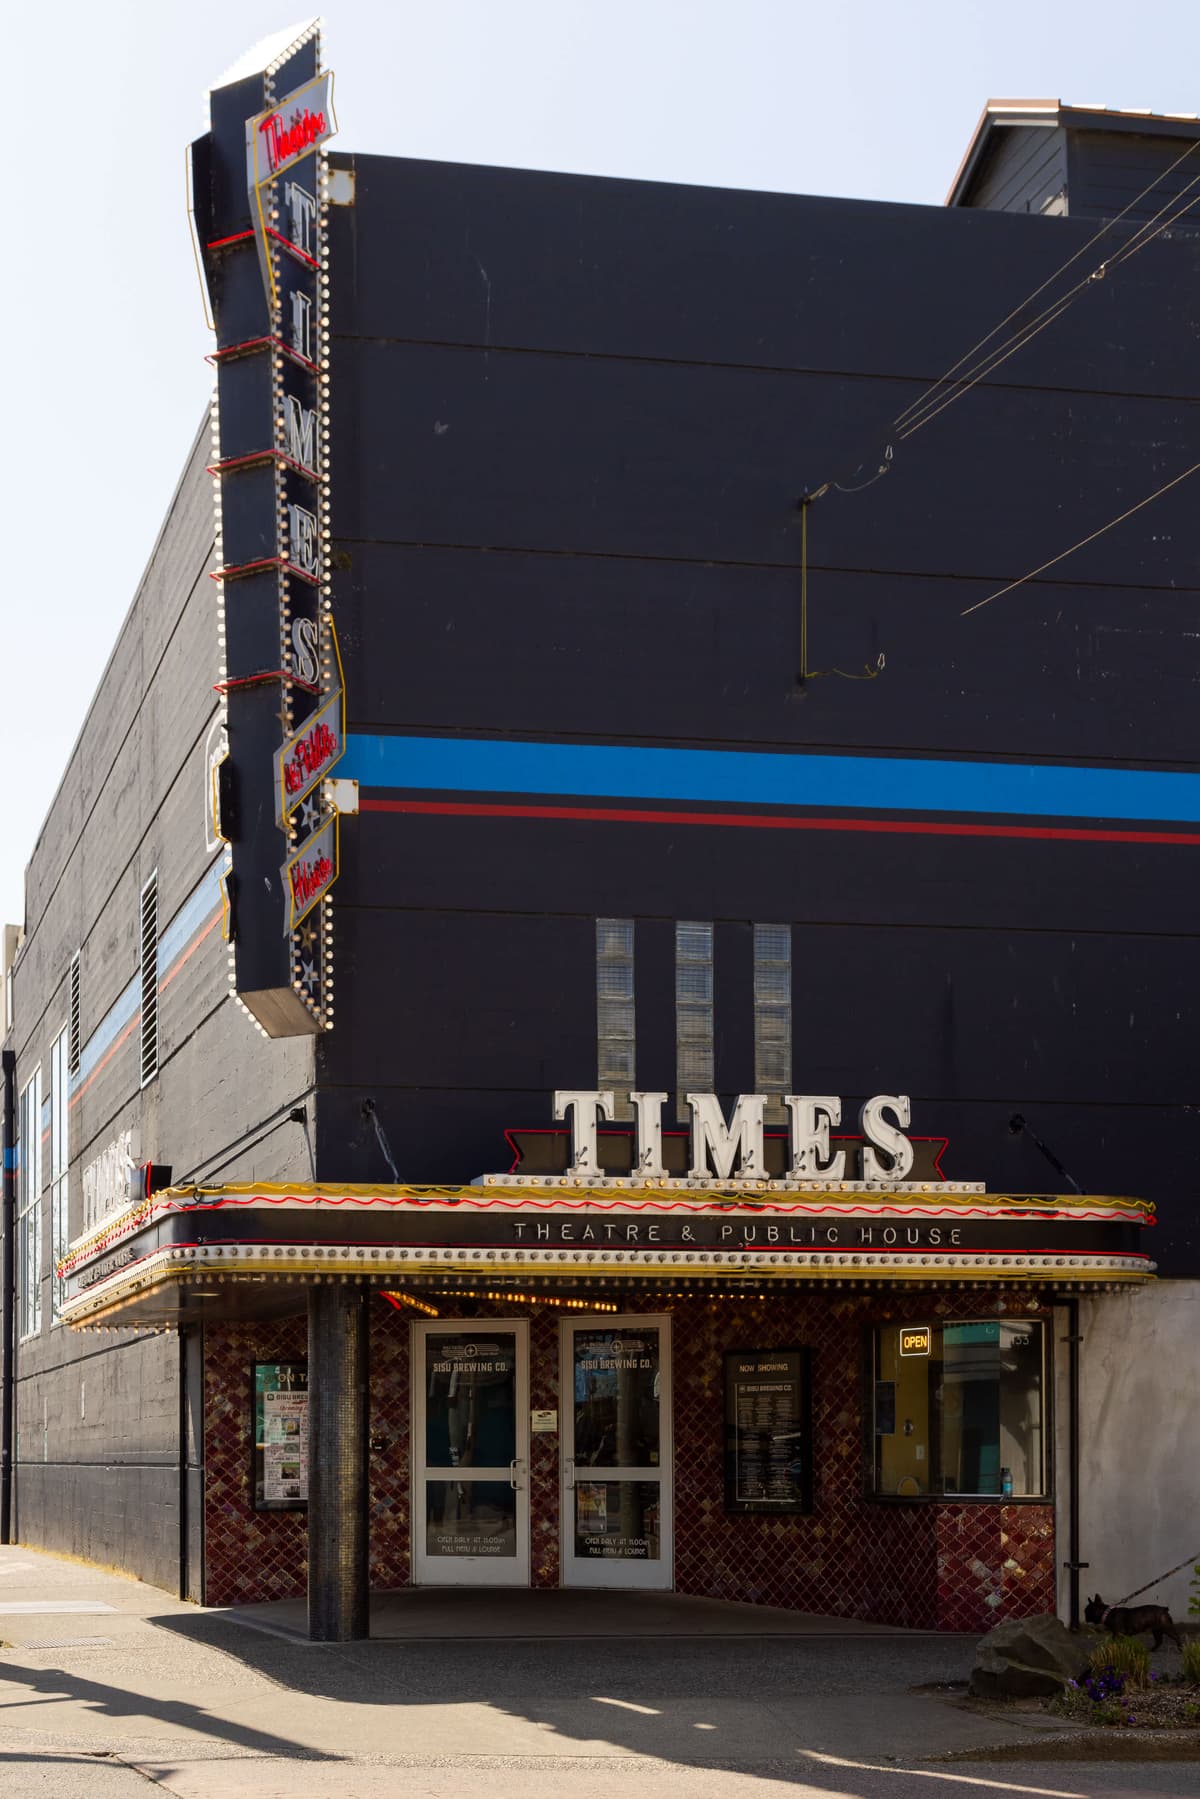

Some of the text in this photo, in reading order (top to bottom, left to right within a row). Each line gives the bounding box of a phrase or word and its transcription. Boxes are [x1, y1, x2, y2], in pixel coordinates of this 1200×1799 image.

[281, 181, 321, 685] TIMES
[552, 1090, 914, 1182] TIMES
[514, 1223, 962, 1246] THEATRE & PUBLIC HOUSE
[904, 1335, 927, 1349] OPEN
[433, 1362, 508, 1373] SISU BREWING CO.
[581, 1359, 652, 1369] SISU BREWING CO.
[739, 1363, 789, 1372] NOW SHOWING
[278, 1373, 295, 1383] ON
